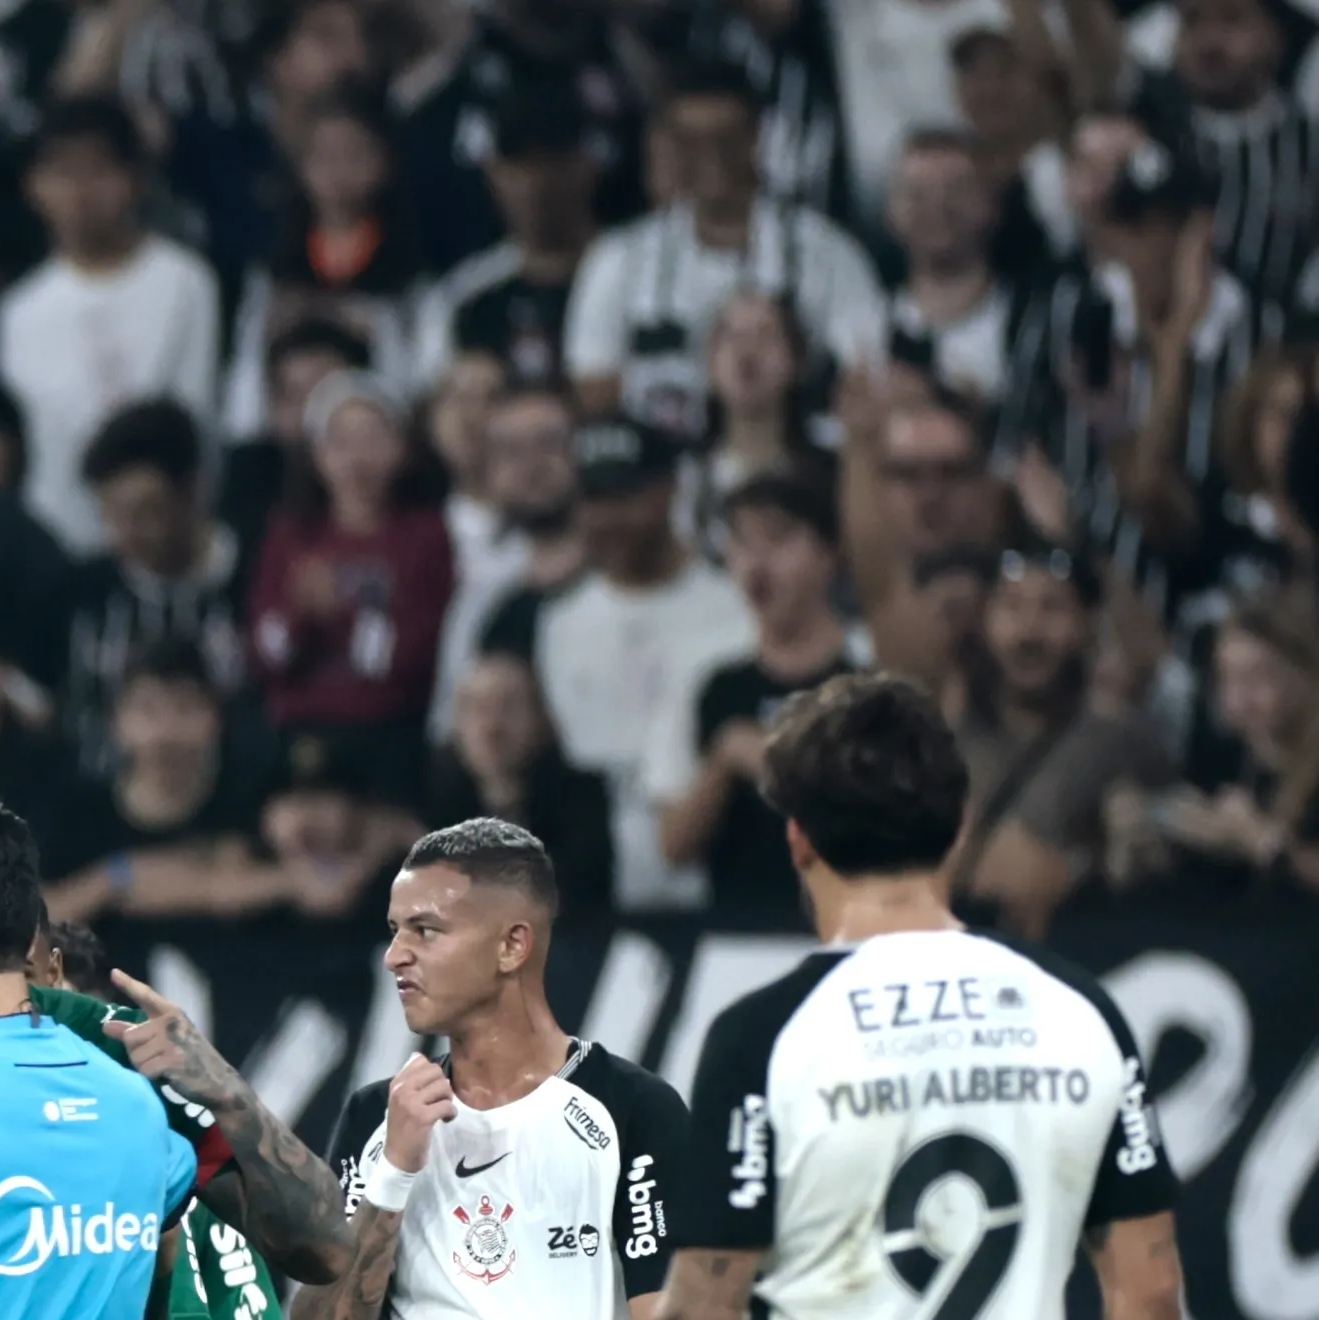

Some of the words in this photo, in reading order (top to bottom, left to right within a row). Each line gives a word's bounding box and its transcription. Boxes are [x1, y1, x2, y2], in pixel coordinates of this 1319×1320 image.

[848, 978, 986, 1031] EZZE
[972, 1027, 1037, 1049] AUTO
[819, 1074, 910, 1122] YURI
[922, 1067, 1092, 1107] ALBERTO
[564, 1096, 611, 1151] Frimesa
[1, 1190, 158, 1268] Midea
[548, 1226, 577, 1250] Zé
[626, 1180, 657, 1259] bmg
[654, 1200, 666, 1237] banco
